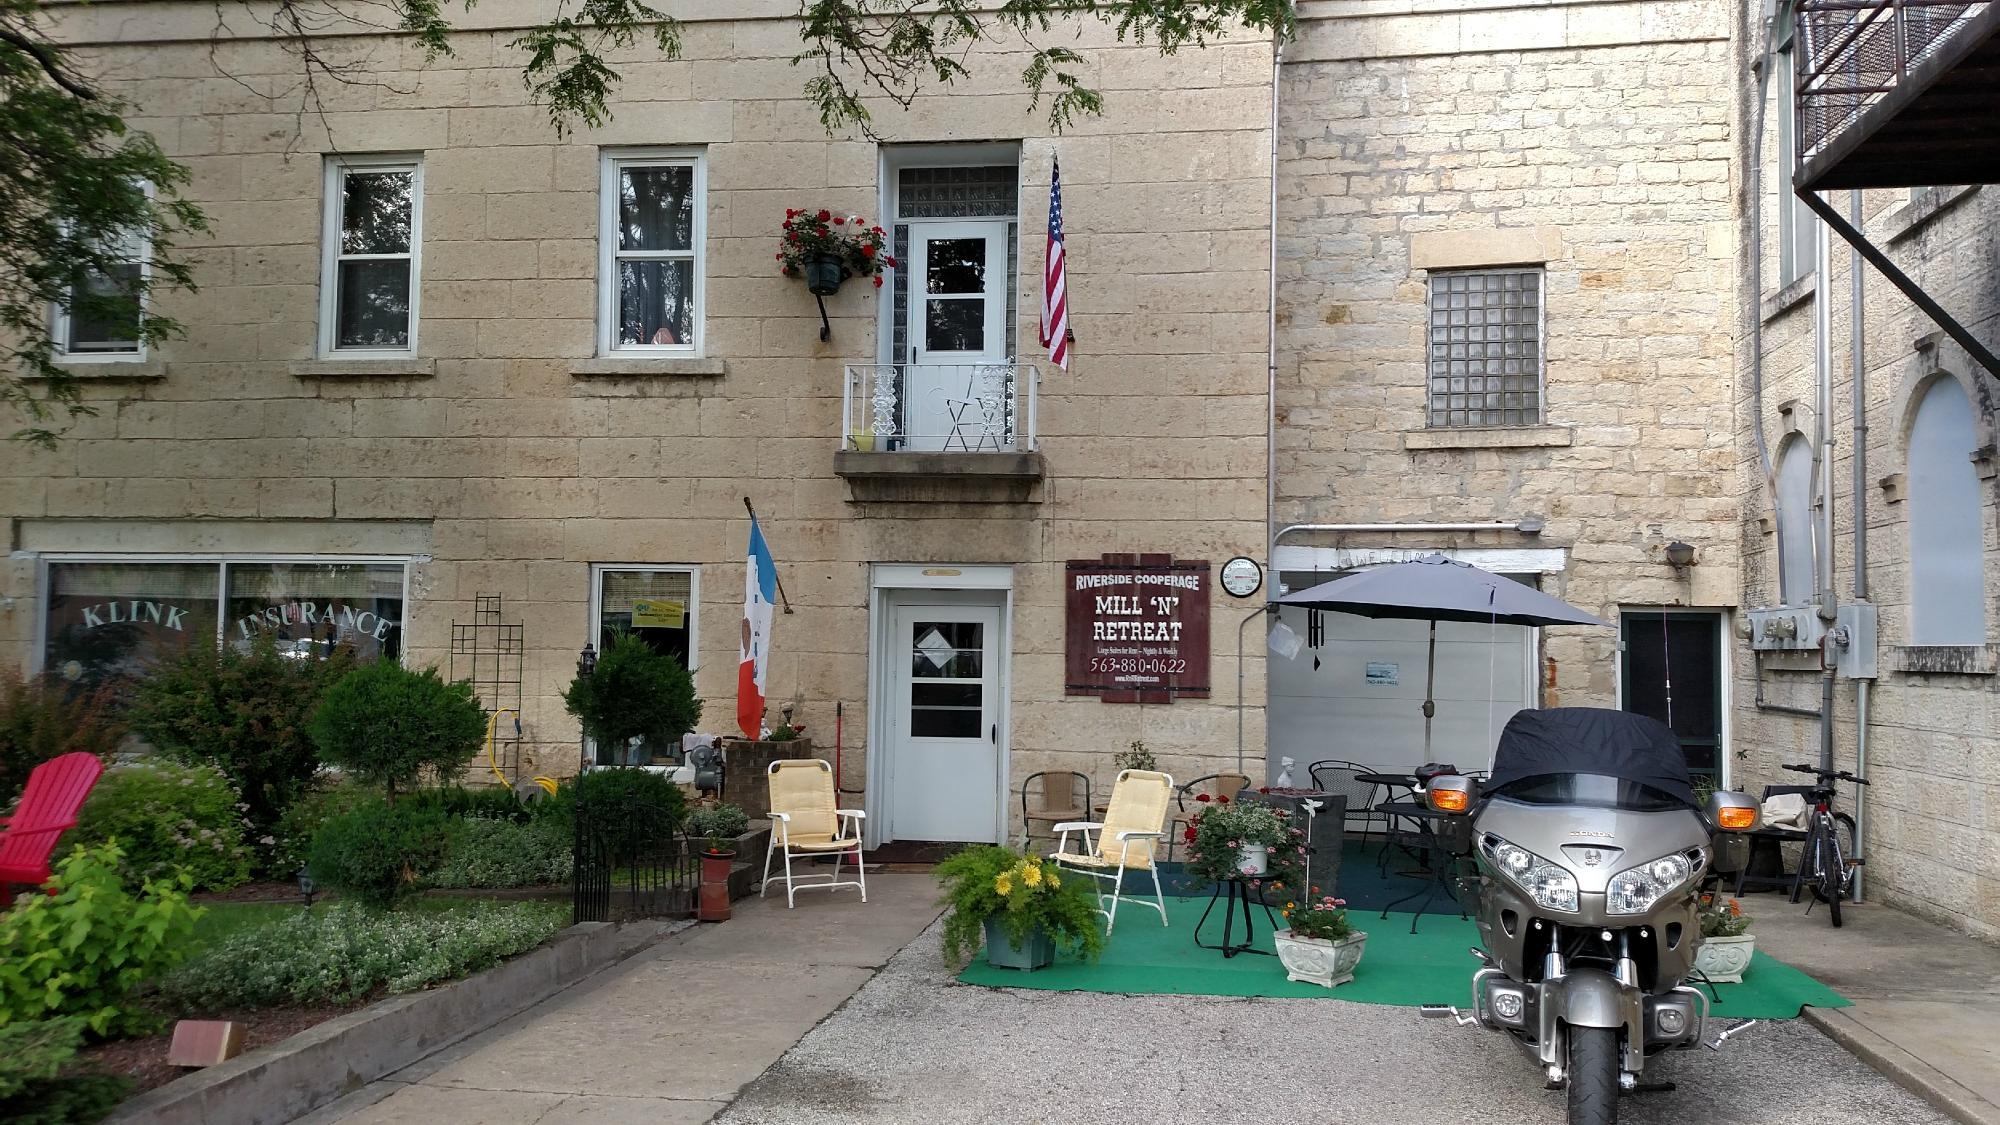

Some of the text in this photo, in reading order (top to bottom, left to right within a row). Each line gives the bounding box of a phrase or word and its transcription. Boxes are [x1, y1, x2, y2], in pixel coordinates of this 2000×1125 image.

[1075, 574, 1199, 590] RIVERSIDE COOPERAGE
[1095, 595, 1143, 615] MILL
[81, 600, 393, 642] KLINK INSURANCE
[1093, 621, 1183, 641] RETREAT
[1097, 646, 1109, 655] Large
[1158, 647, 1163, 655] &
[1090, 657, 1186, 673] 563-880-0622
[1568, 831, 1615, 839] HONDA
